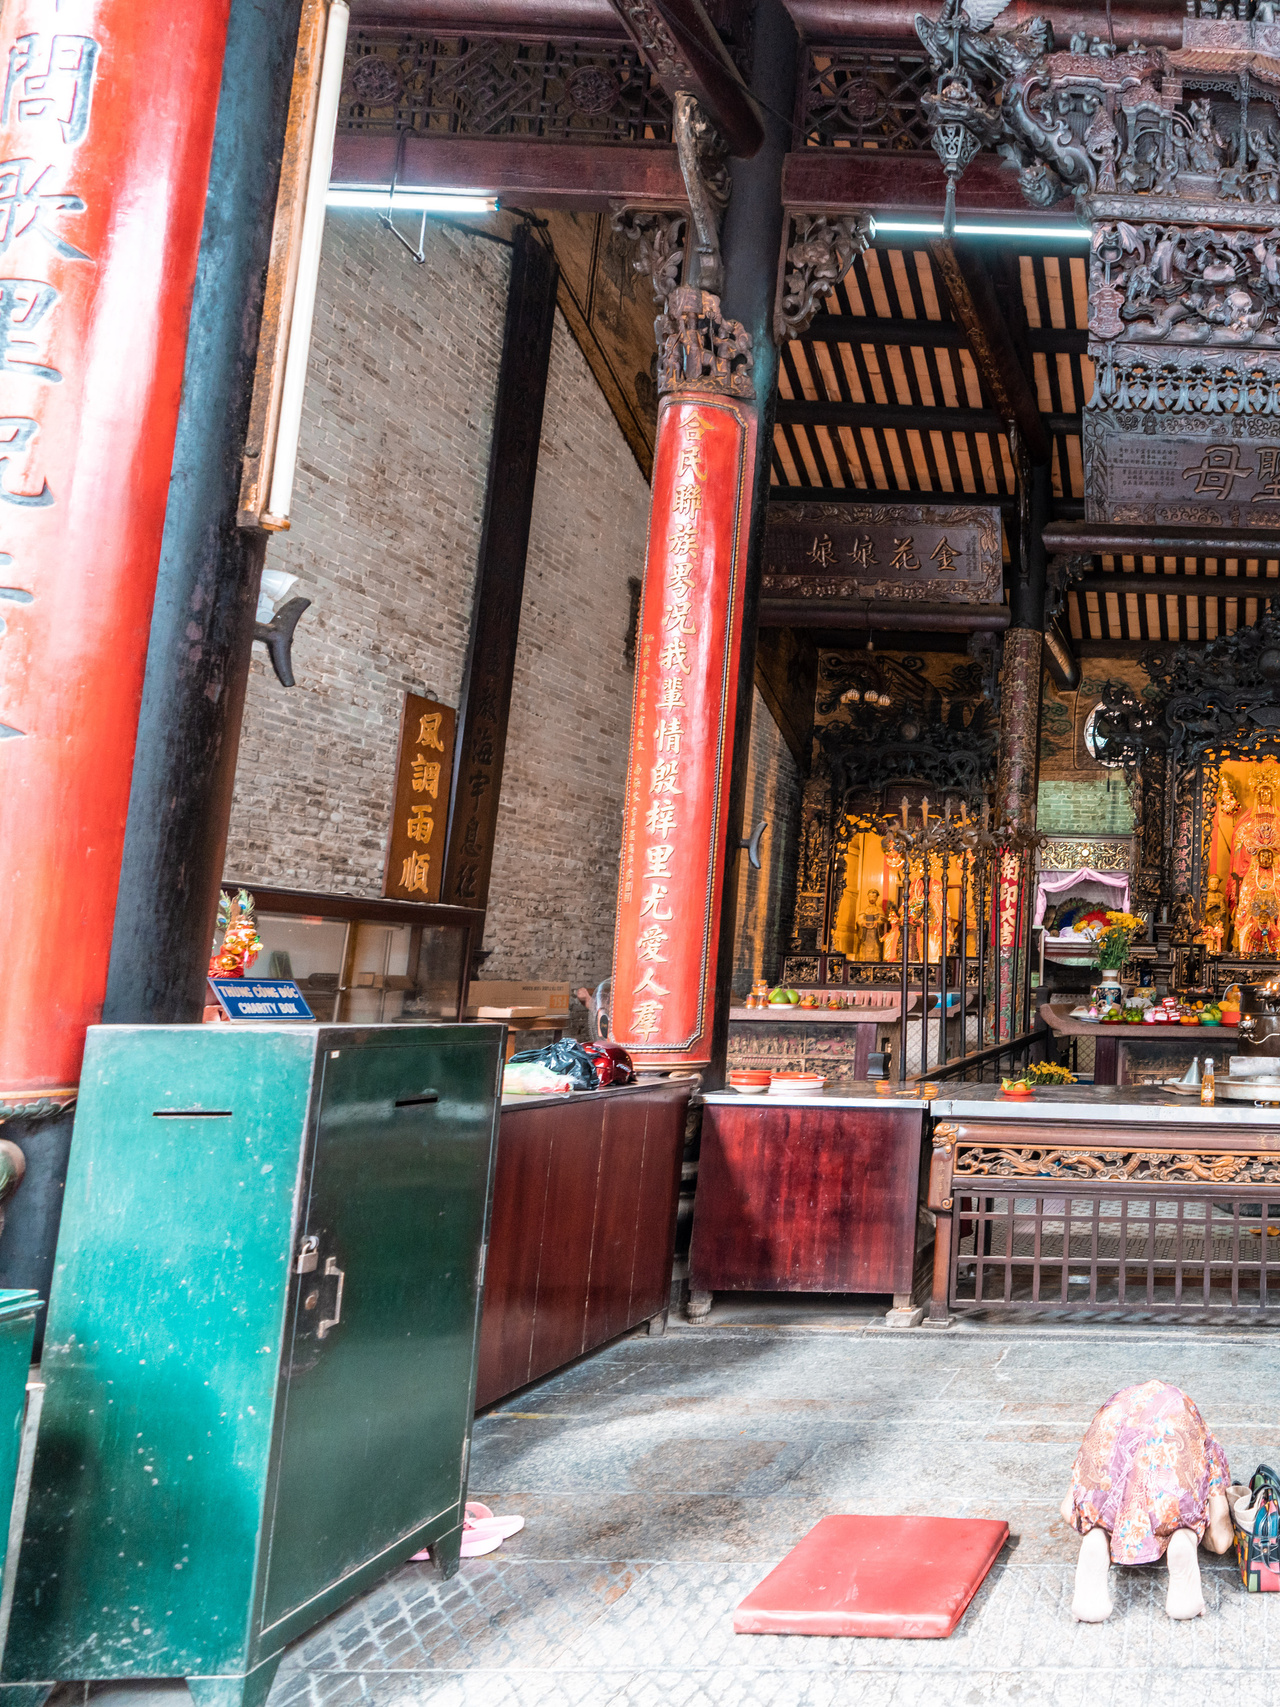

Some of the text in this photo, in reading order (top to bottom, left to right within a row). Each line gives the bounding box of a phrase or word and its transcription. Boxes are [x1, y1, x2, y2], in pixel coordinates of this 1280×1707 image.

[806, 533, 962, 571] 金花娘娘
[399, 712, 444, 894] 風調雨順
[252, 984, 279, 998] CÔNG
[238, 1002, 300, 1014] CHARITY BOX
